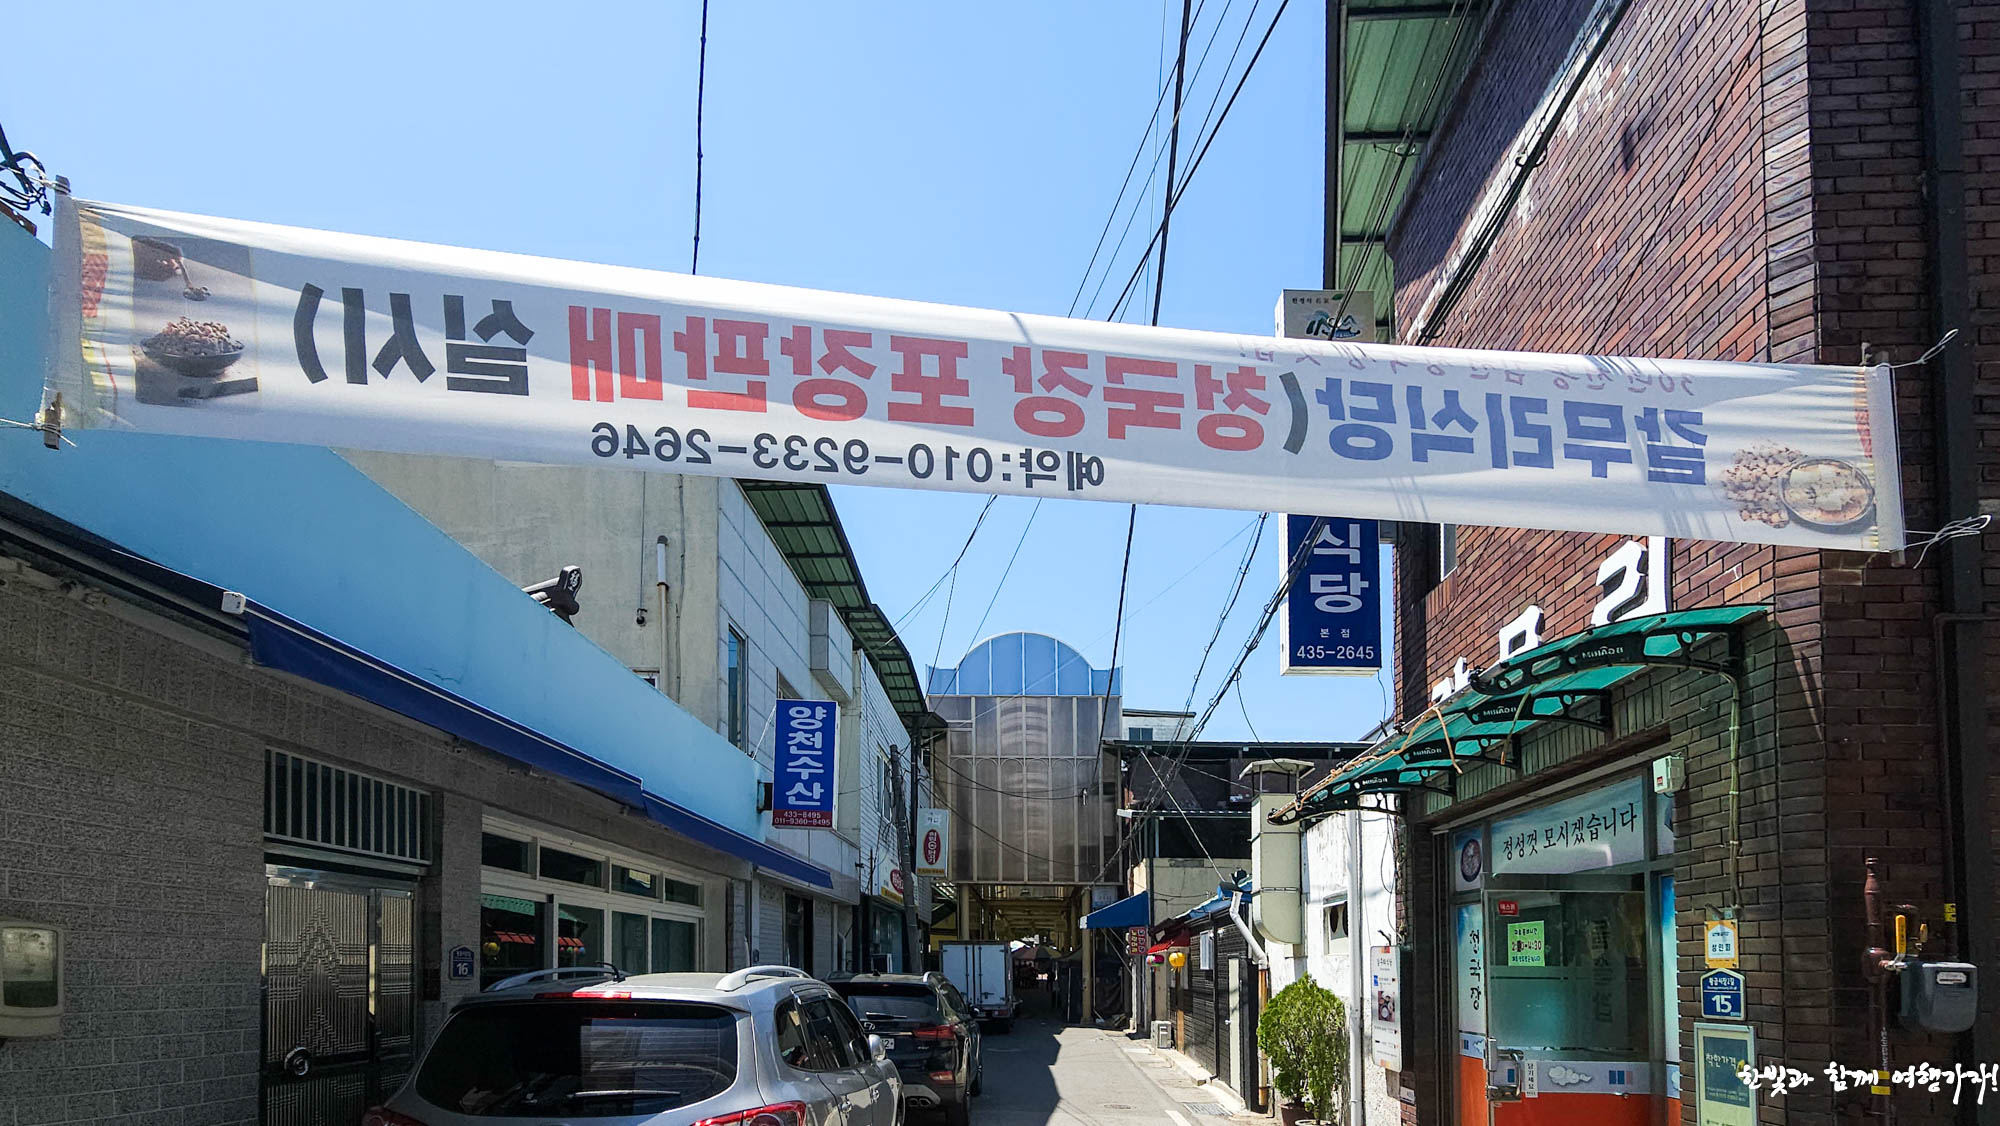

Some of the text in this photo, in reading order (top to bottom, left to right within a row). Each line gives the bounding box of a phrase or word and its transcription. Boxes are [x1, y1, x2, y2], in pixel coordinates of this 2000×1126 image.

[1310, 523, 1369, 613] 식당
[1296, 645, 1374, 660] 435-2645
[785, 706, 827, 806] 양천수산
[783, 811, 821, 819] 433-8495
[1502, 802, 1637, 861] 정성껏 모시겠습니다
[456, 962, 469, 976] 16
[1711, 994, 1732, 1013] 15
